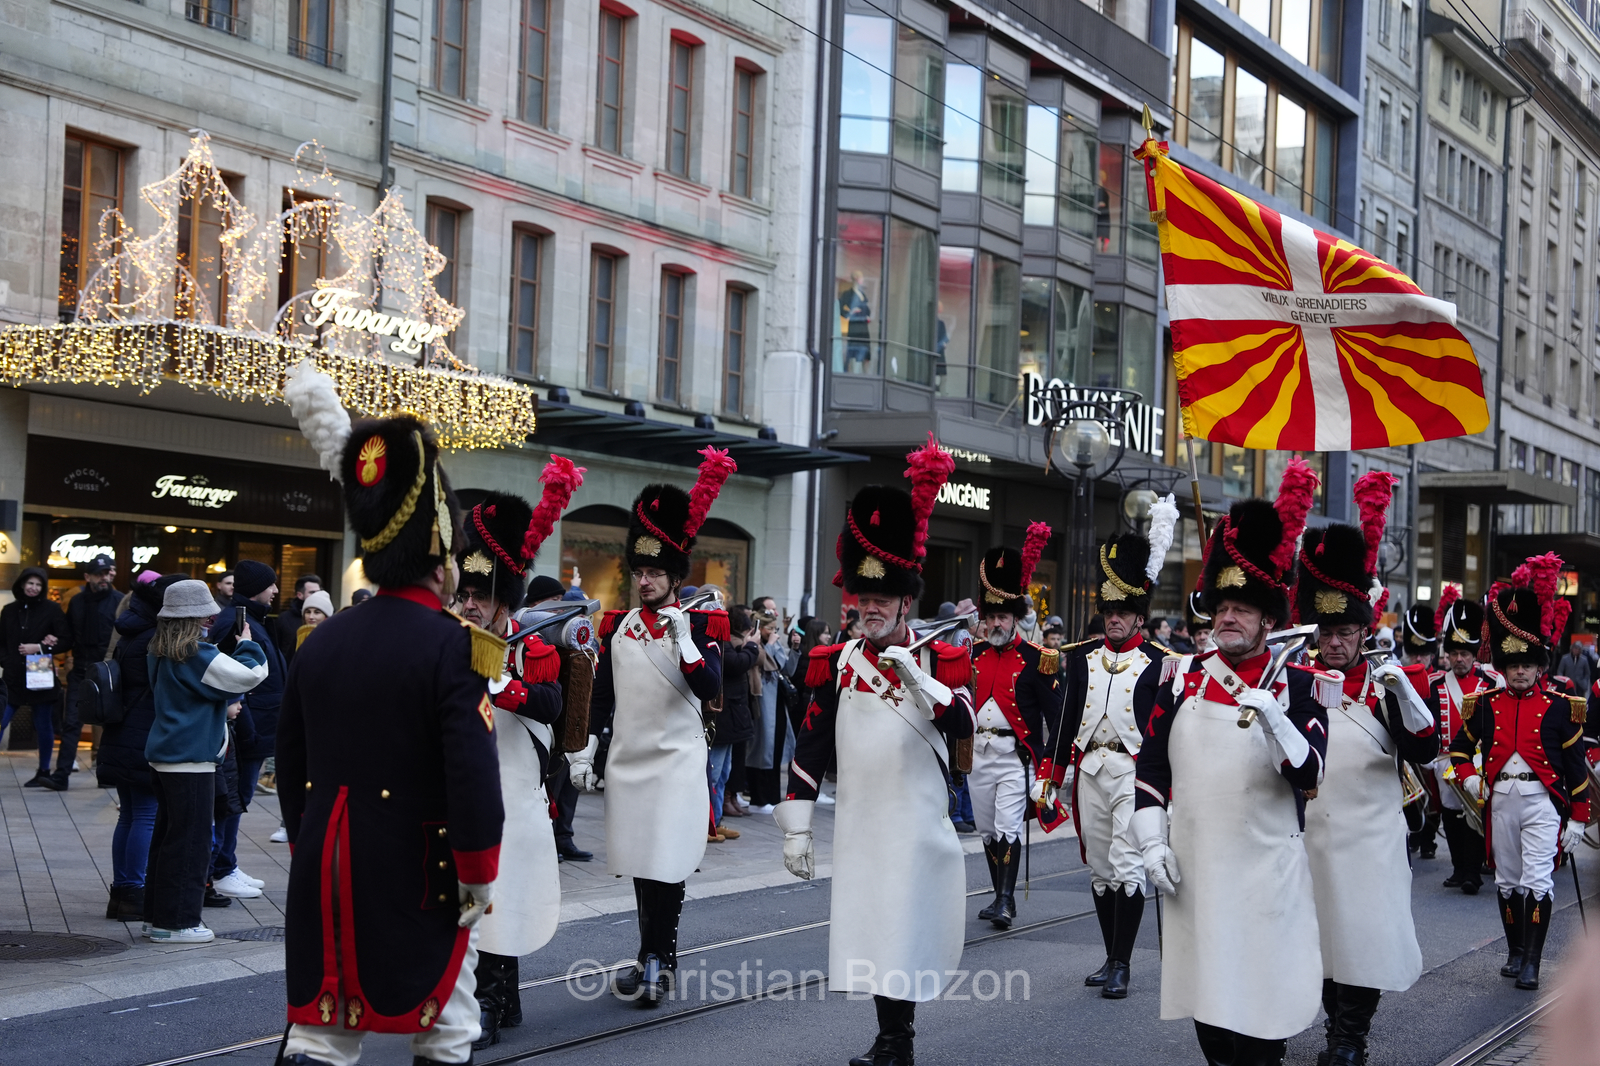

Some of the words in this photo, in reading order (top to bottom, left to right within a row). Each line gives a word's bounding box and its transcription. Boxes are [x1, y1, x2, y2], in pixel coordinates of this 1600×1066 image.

[1261, 291, 1290, 306] VIEUX
[1295, 297, 1368, 311] GRENADIERS
[304, 287, 444, 355] Favarger
[1290, 310, 1337, 324] GENEVE
[64, 468, 110, 488] CHOCOLAT
[73, 482, 99, 492] SUISSE
[151, 474, 238, 508] Favarger
[934, 481, 991, 511] ONGÉNIE
